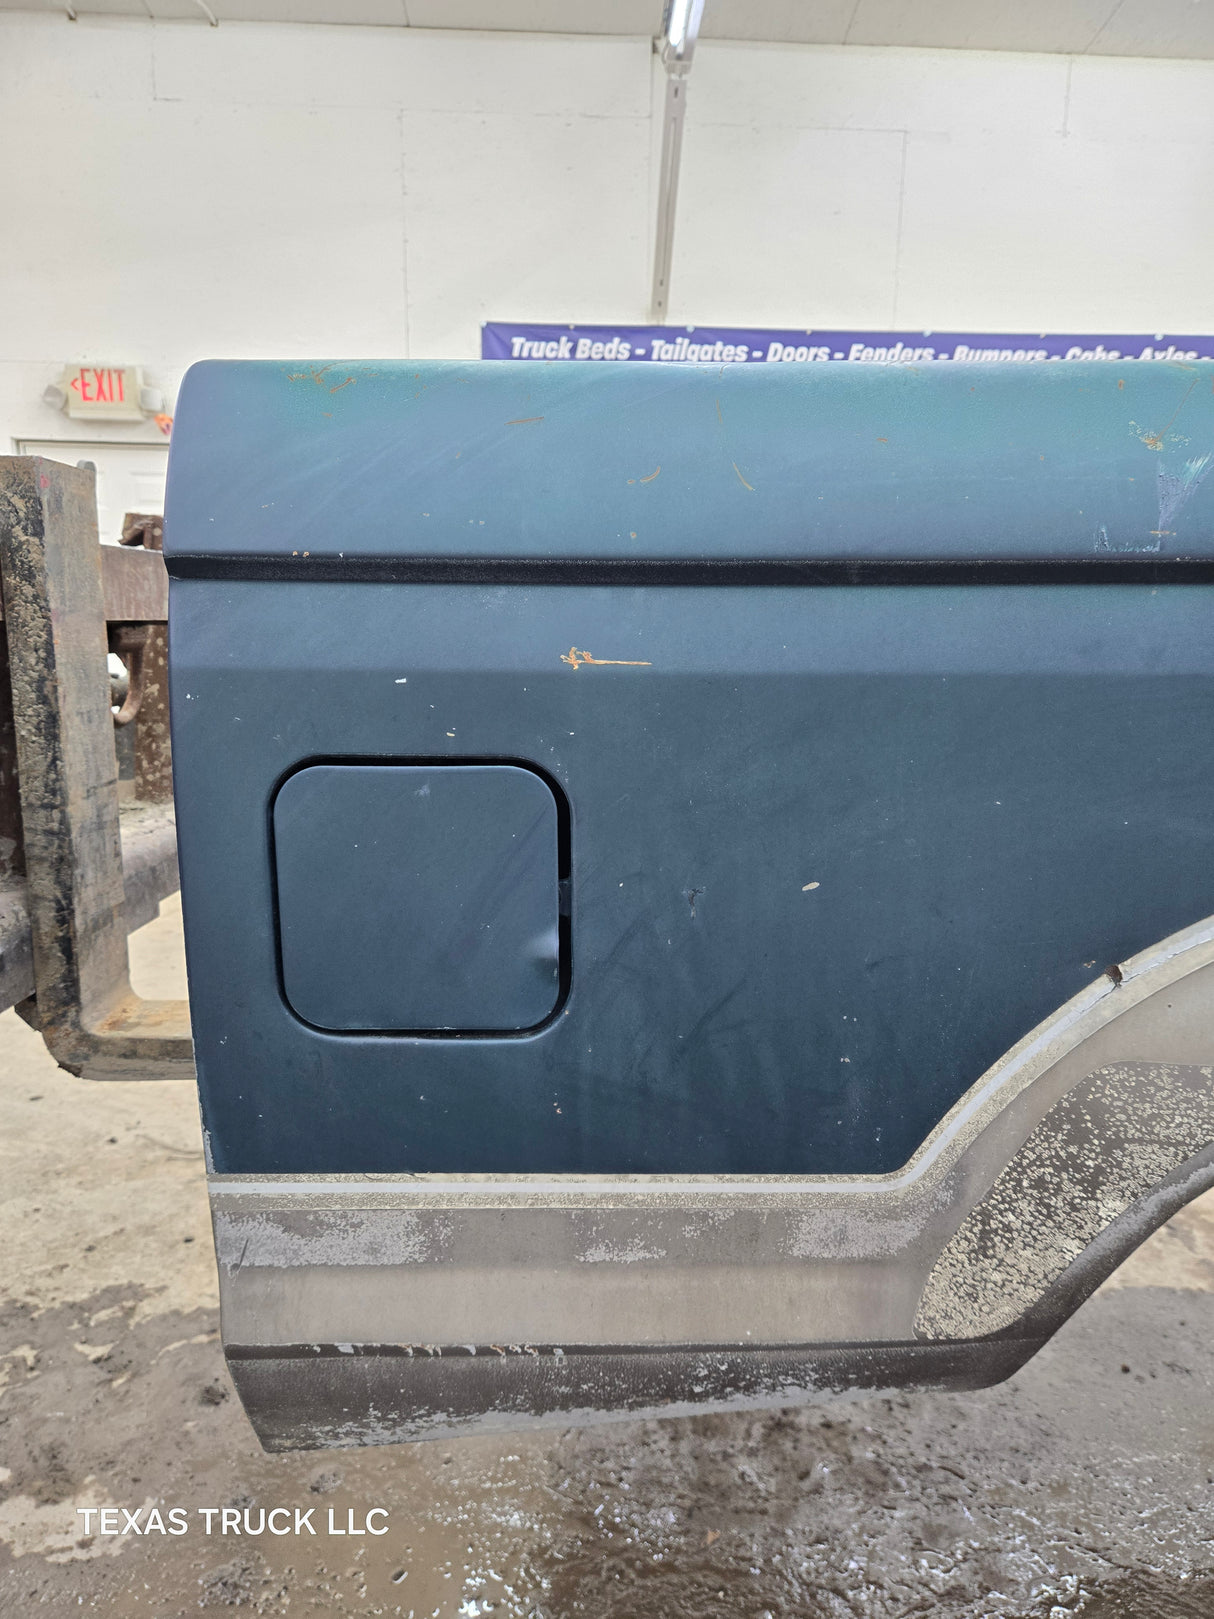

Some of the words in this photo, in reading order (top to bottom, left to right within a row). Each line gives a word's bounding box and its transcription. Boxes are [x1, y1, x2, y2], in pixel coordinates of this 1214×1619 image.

[511, 336, 573, 358] Truck
[575, 337, 631, 360] Beds
[651, 337, 749, 362] Tailgates
[766, 342, 831, 362] Doors
[848, 342, 935, 360] Fenders
[80, 368, 125, 402] EXIT
